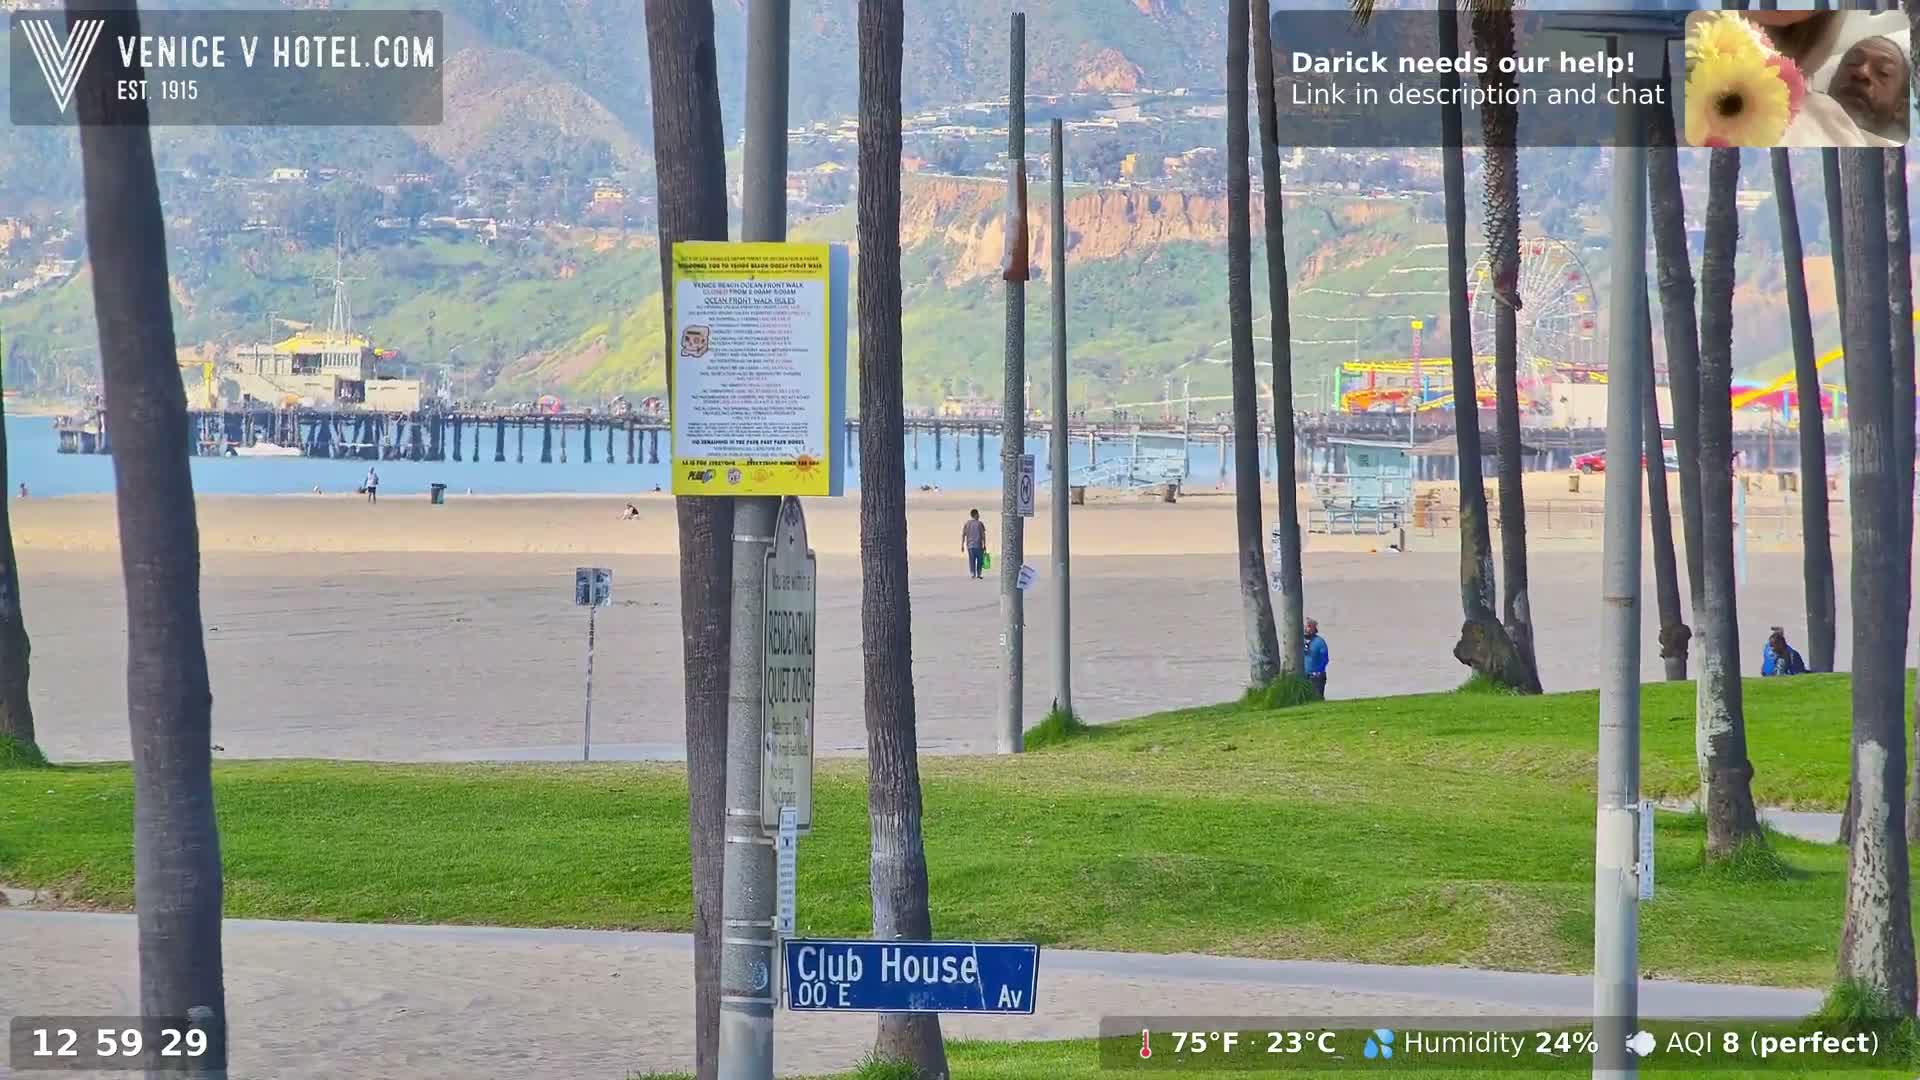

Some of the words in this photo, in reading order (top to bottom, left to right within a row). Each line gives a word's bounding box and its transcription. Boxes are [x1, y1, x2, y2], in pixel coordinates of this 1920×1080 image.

[769, 609, 812, 656] RESIDENTIAL
[767, 666, 791, 708] QUIET
[792, 666, 811, 703] ZONE
[798, 947, 863, 983] Club
[881, 947, 977, 984] House
[838, 983, 851, 1006] E
[998, 984, 1022, 1009] Av
